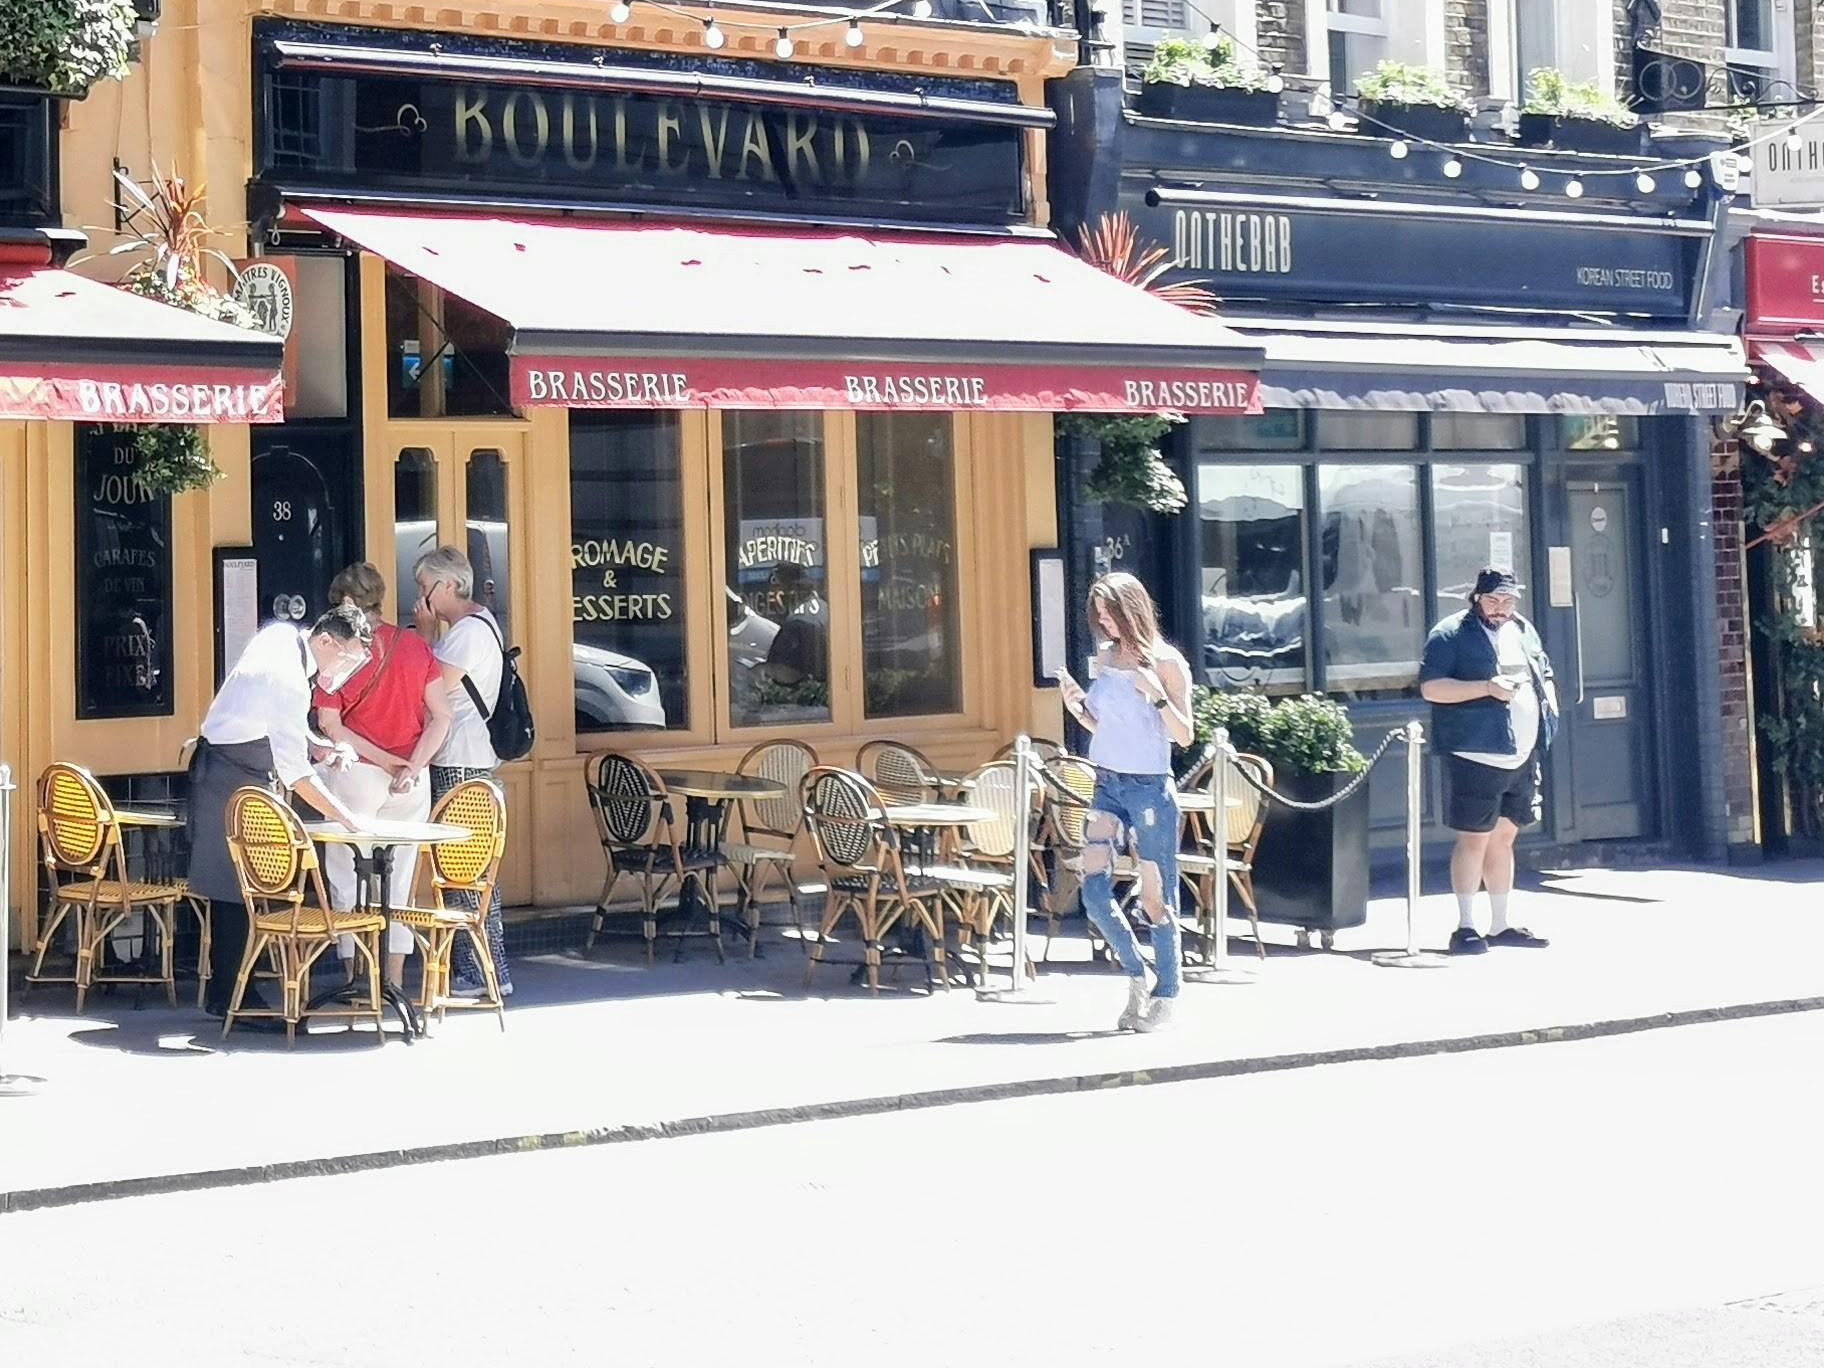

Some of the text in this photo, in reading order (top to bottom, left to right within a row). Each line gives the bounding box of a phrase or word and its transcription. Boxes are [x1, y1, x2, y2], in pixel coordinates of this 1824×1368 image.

[454, 85, 871, 185] BOULEVARD
[1176, 210, 1291, 273] ONTHEBAB
[1577, 267, 1673, 289] KOREAN STREET FOOD
[77, 382, 271, 415] BRASSERIE
[529, 371, 690, 402] BRASSERIE
[844, 375, 988, 405] BRASSERIE
[1125, 380, 1248, 408] BRASSERIE
[114, 447, 135, 464] DU
[93, 474, 155, 504] JOUR
[273, 500, 292, 521] 38
[94, 550, 156, 568] CARAFES
[603, 570, 617, 588] &
[104, 634, 147, 657] PRIX
